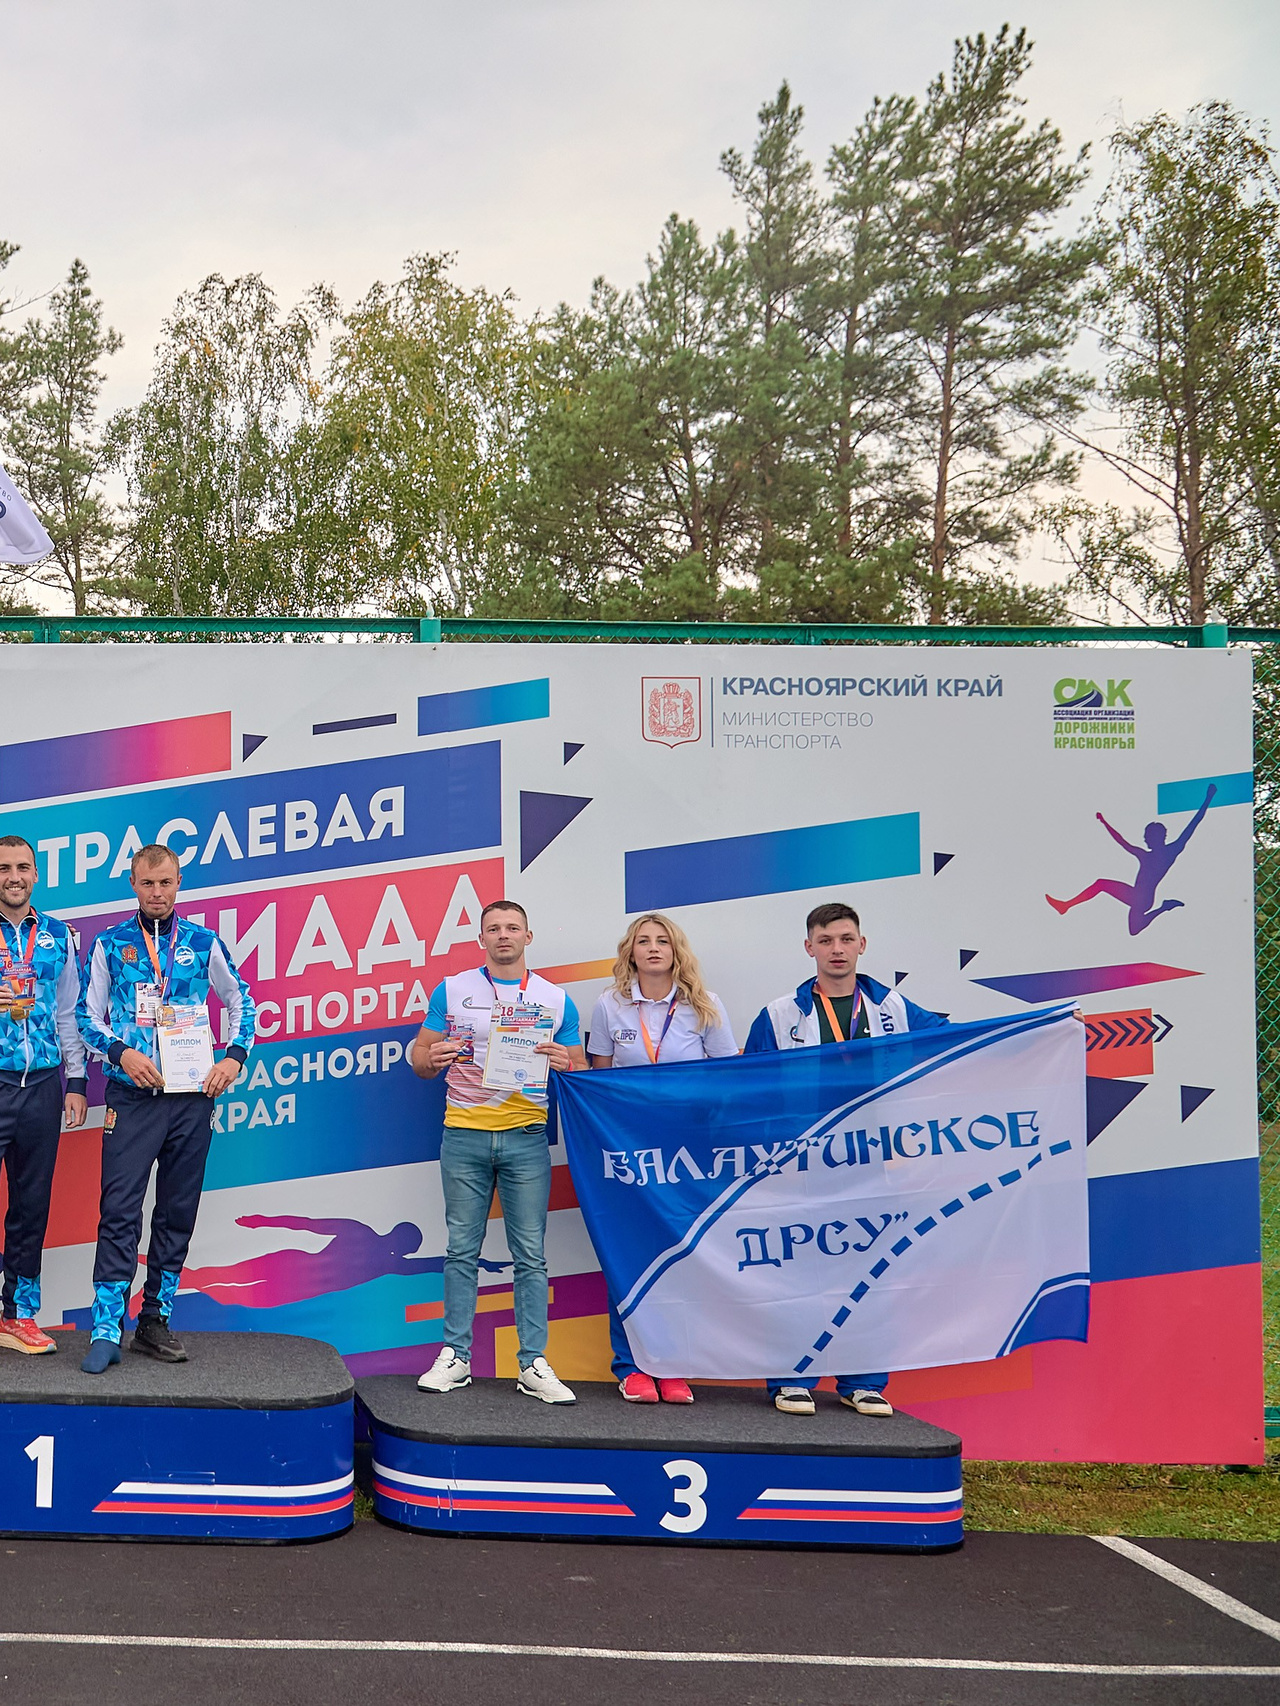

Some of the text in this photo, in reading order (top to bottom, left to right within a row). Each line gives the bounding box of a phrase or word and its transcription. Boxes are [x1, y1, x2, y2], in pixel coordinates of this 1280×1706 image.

[722, 674, 1004, 697] КРАСНОЯРСКИЙ КРАЙ
[722, 711, 874, 727] МИНИСТЕРСТВО
[1053, 721, 1135, 736] ДОРОЖНИКИ
[723, 733, 842, 749] ТРАНСПОРТА
[1054, 736, 1135, 749] КРАСНОЯРЬЯ
[37, 785, 406, 888] ТРАСЛЕВАЯ
[500, 1006, 514, 1017] 18
[170, 1038, 202, 1047] ДИПЛОМ
[501, 1035, 539, 1047] ДИПЛОМ
[601, 1110, 1040, 1187] БАЛАХТИНСКОЕ
[23, 1435, 55, 1508] 1
[658, 1459, 709, 1533] 3
